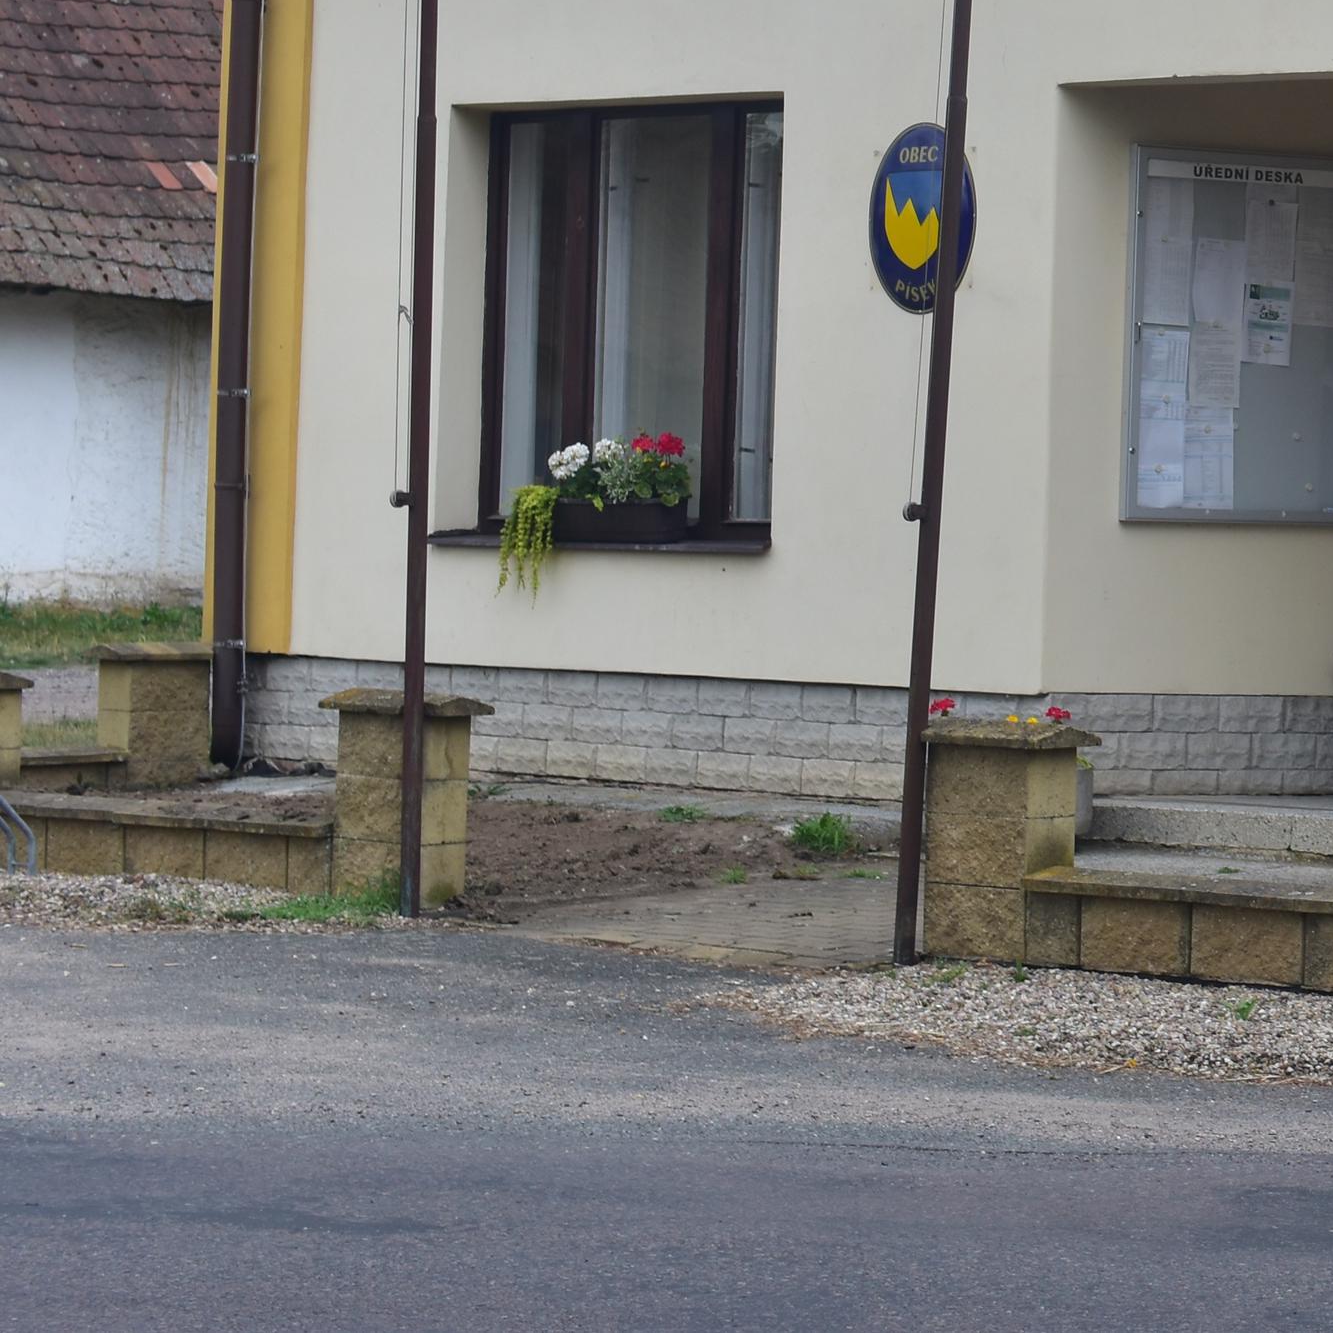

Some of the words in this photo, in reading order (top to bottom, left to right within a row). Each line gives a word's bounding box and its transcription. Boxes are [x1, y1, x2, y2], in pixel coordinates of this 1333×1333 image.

[899, 145, 939, 164] OBEC
[1193, 163, 1250, 181] ÚŘEDNÍ
[1255, 169, 1304, 185] DESKA
